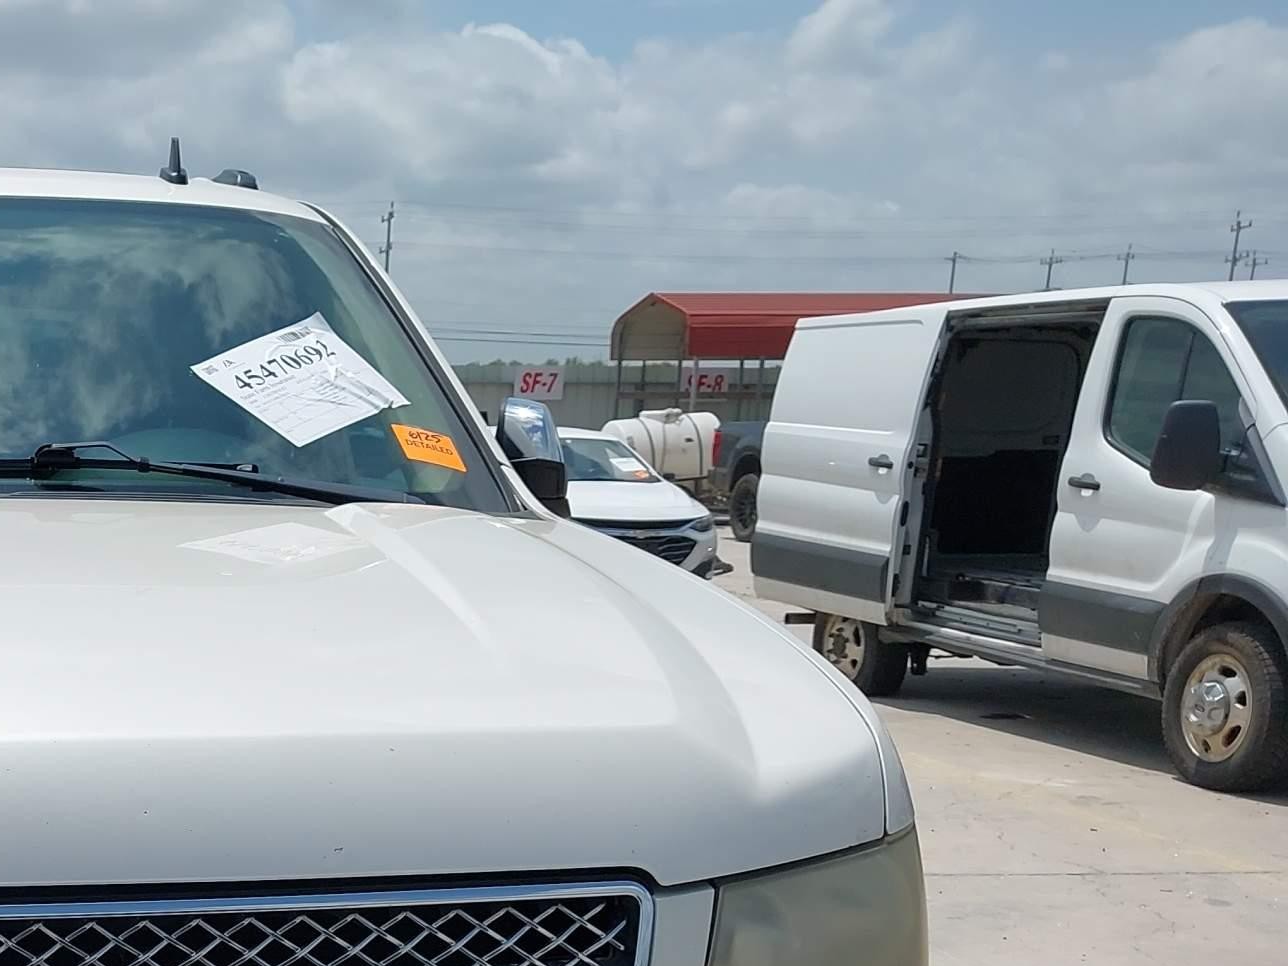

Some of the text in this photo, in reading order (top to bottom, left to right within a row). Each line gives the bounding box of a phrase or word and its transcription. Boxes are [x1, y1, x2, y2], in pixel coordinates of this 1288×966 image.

[234, 340, 336, 389] 45470692
[520, 372, 559, 393] SF-7
[405, 439, 454, 456] DETAILED
